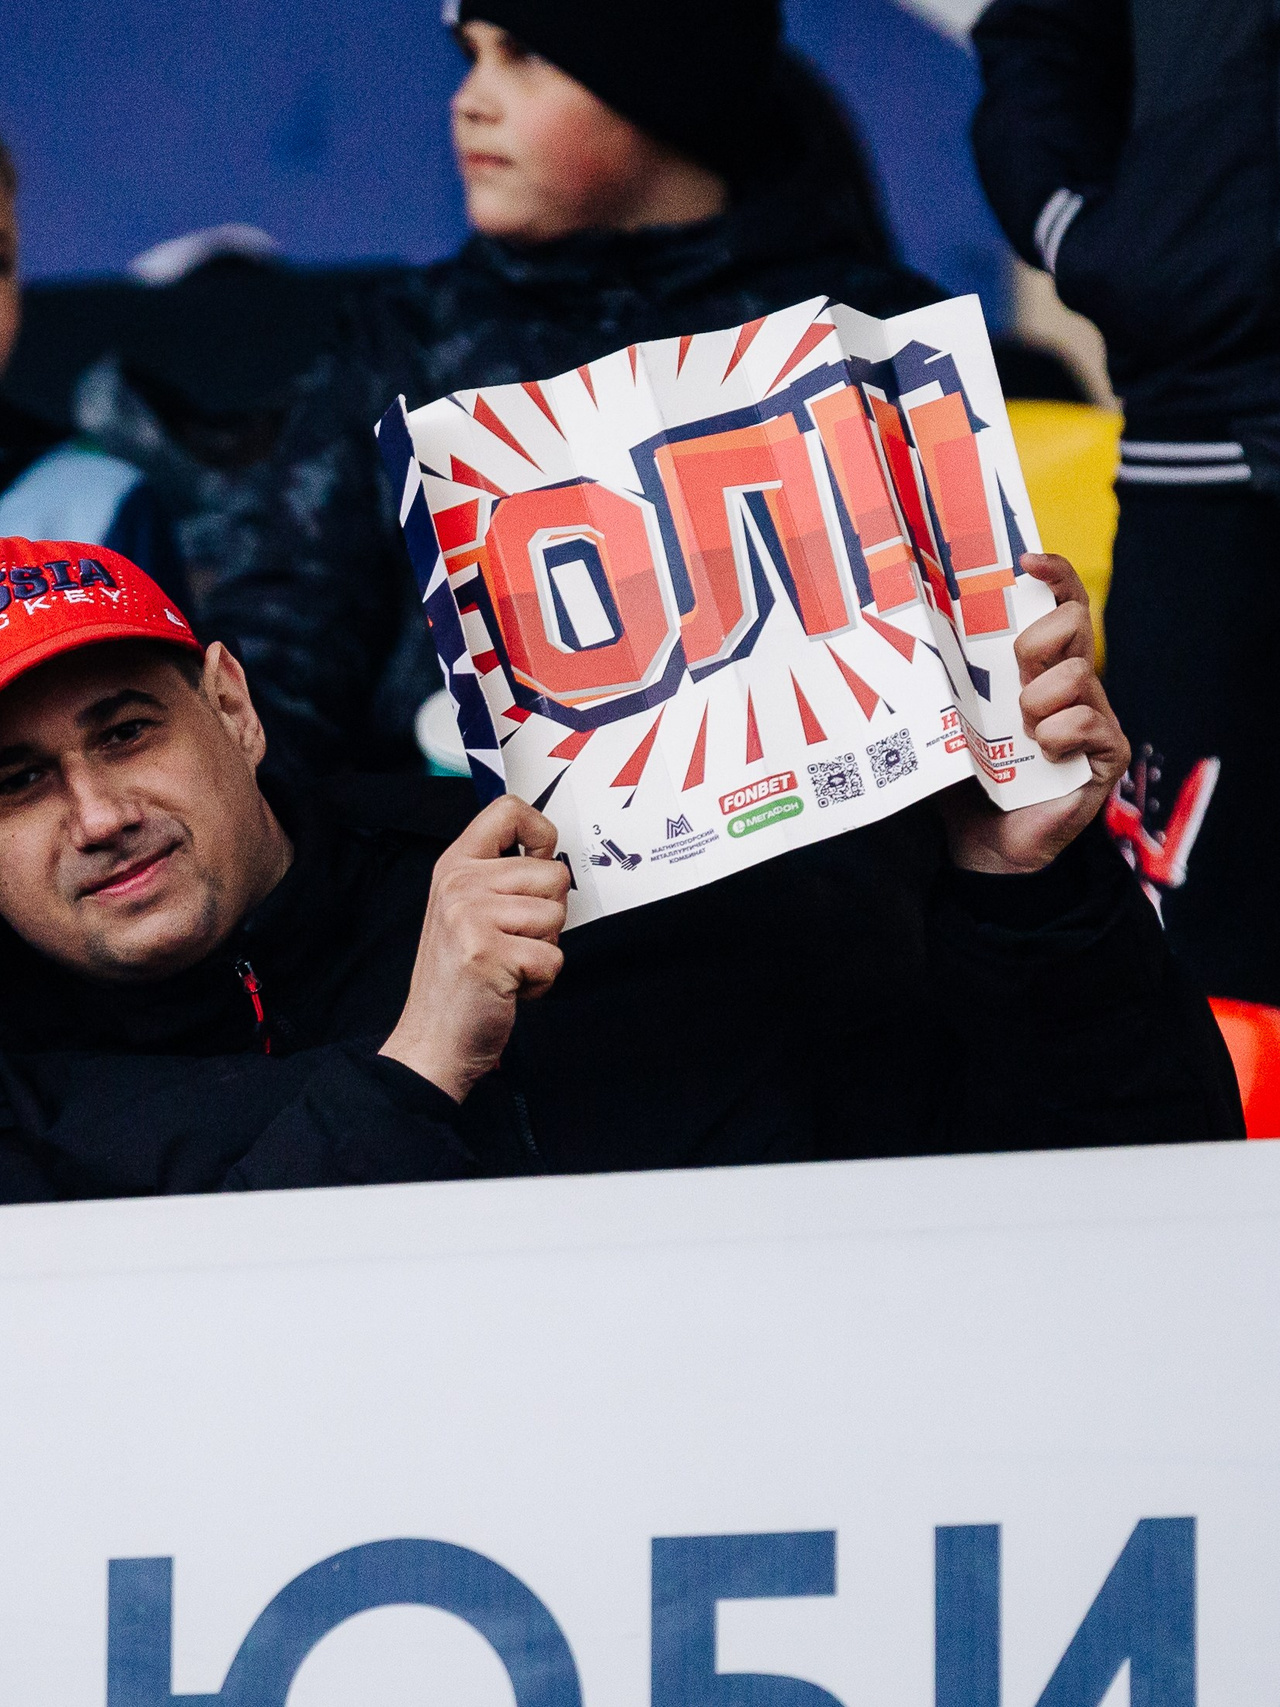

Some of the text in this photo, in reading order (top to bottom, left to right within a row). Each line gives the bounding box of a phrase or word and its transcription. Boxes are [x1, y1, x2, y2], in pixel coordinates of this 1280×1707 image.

[723, 774, 791, 813] FONBET
[746, 801, 799, 827] МЕГАФОН
[592, 824, 601, 835] 3
[651, 828, 715, 854] МАГНИТОГОРСКИЙ
[650, 834, 720, 862] МЕТАЛЛУРГИЧЕСКИЙ
[669, 848, 706, 864] КОМБИНАТ
